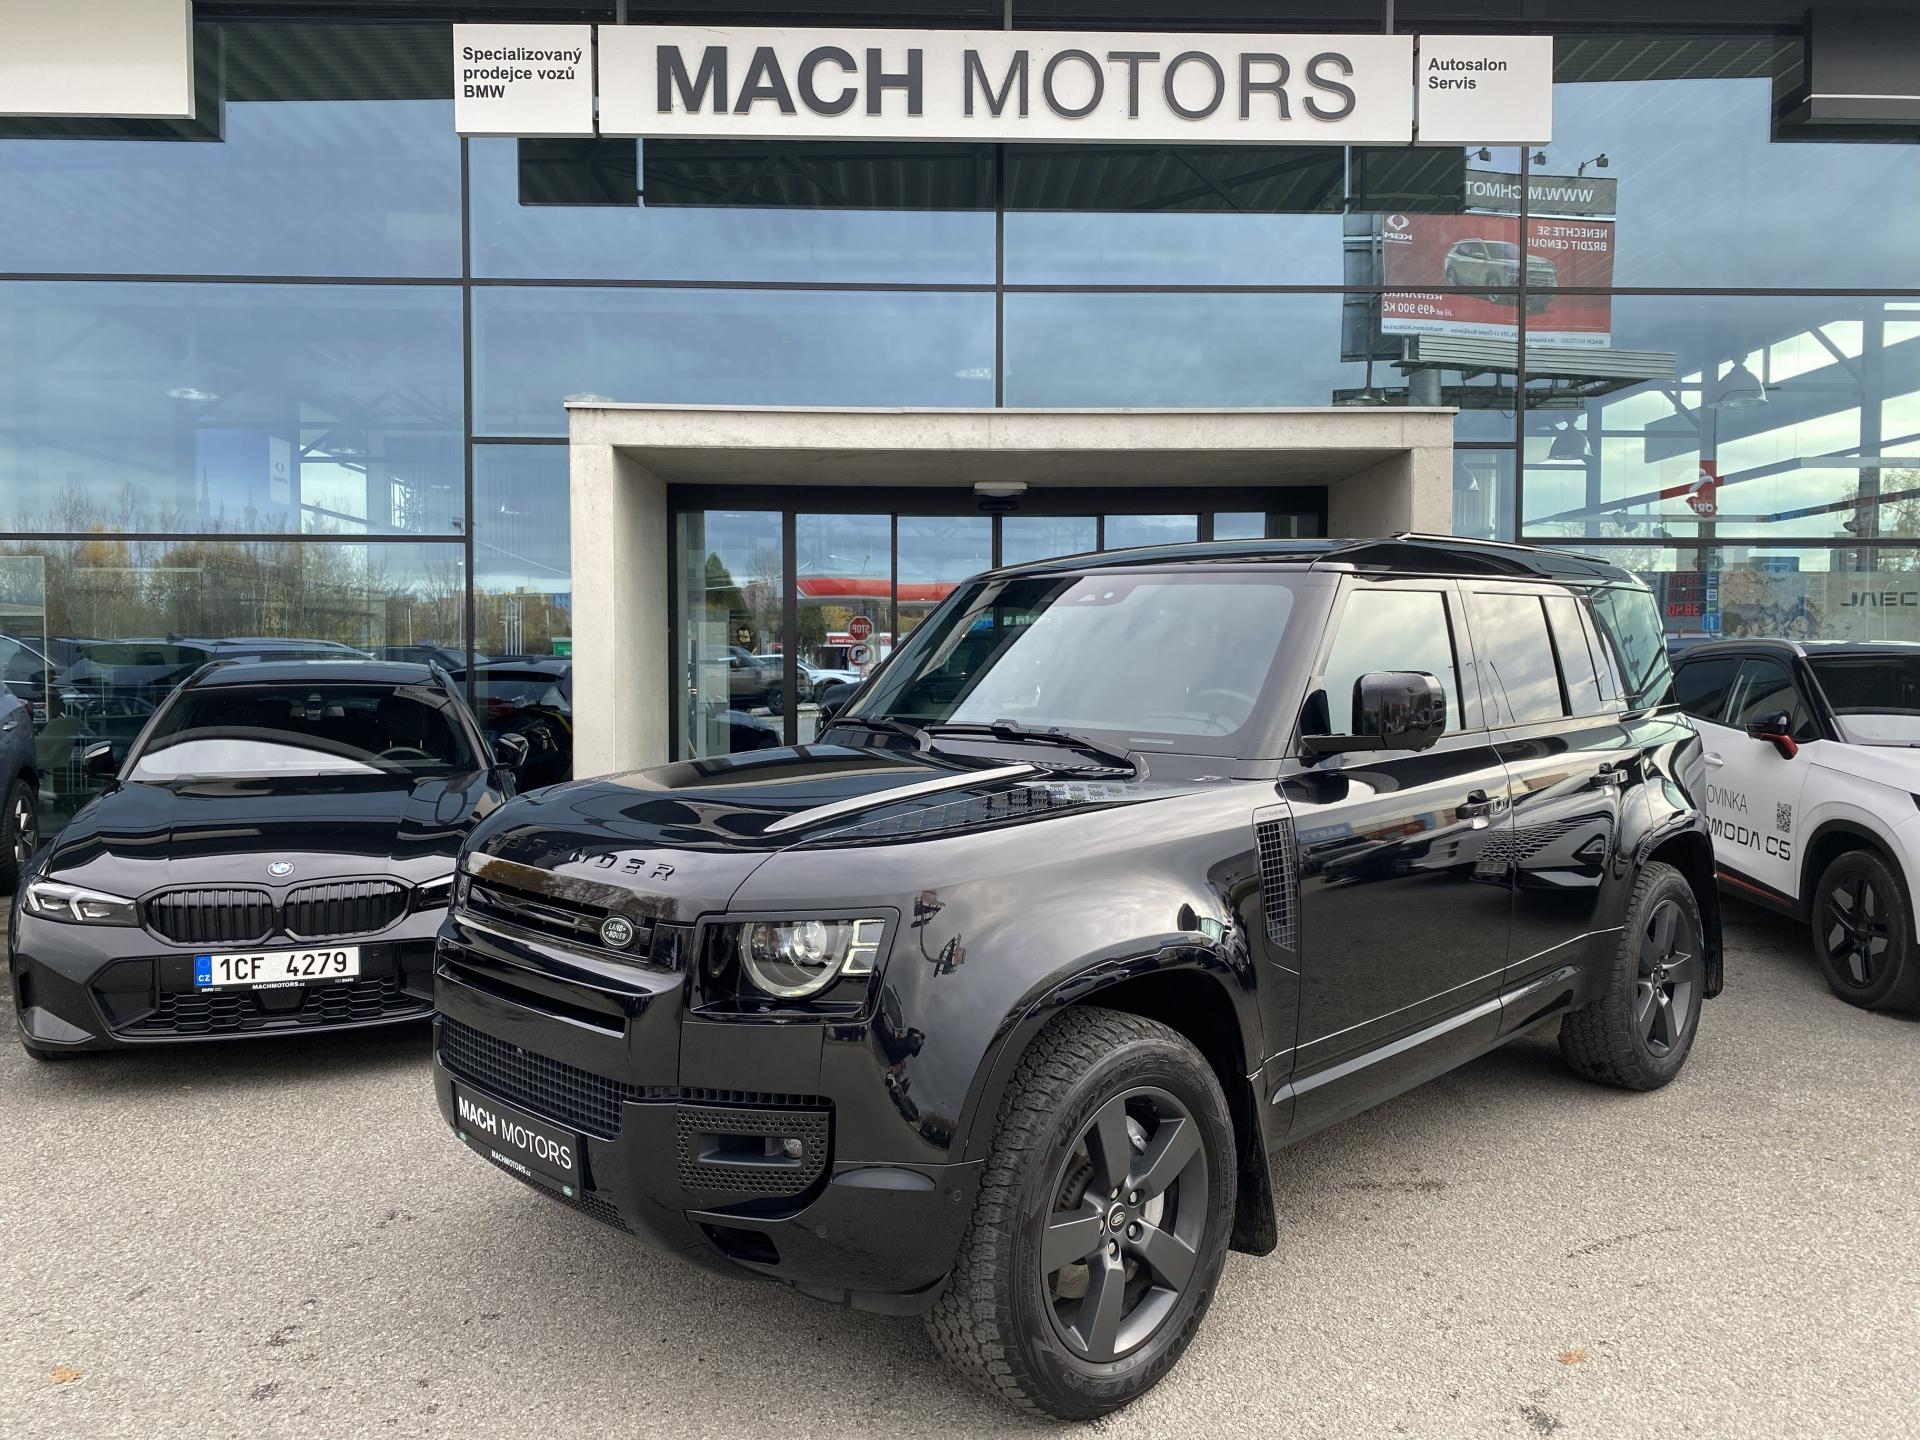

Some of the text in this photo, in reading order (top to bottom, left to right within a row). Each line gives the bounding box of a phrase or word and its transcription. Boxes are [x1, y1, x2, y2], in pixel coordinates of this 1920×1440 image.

[462, 47, 583, 65] Specializovaný
[1428, 57, 1508, 72] Autosalon
[463, 64, 576, 82] prodejce vozů
[656, 45, 1357, 123] MACH MOTORS
[1428, 76, 1477, 90] Servis
[463, 84, 506, 99] BMW
[1705, 784, 1748, 814] OVINKA
[608, 922, 625, 932] LAND
[608, 932, 627, 940] ROVER
[219, 951, 347, 981] 1CF 4279
[198, 974, 211, 982] CZ
[458, 1096, 572, 1170] MACH MOTORS
